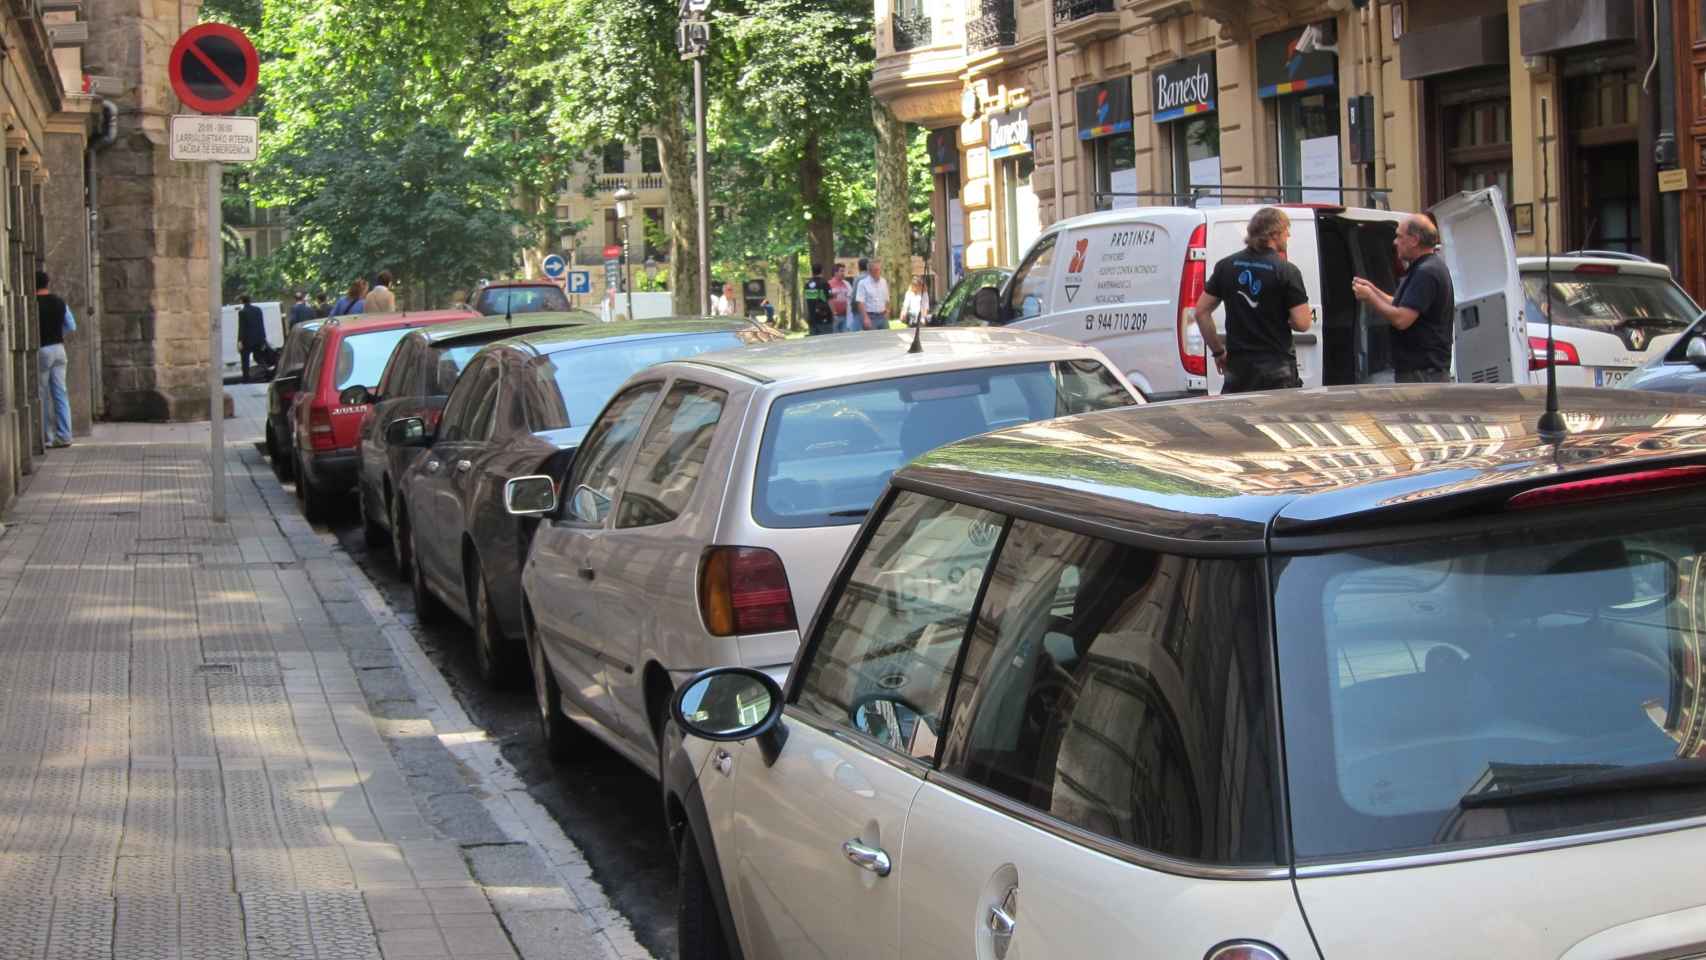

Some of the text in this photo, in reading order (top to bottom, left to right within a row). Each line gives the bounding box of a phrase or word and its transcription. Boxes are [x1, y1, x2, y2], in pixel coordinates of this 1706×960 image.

[1156, 63, 1209, 111] Banesto
[990, 111, 1028, 149] Banesto
[1110, 231, 1155, 248] PROTINSA
[571, 272, 586, 292] P
[1098, 312, 1147, 330] 944 710 209
